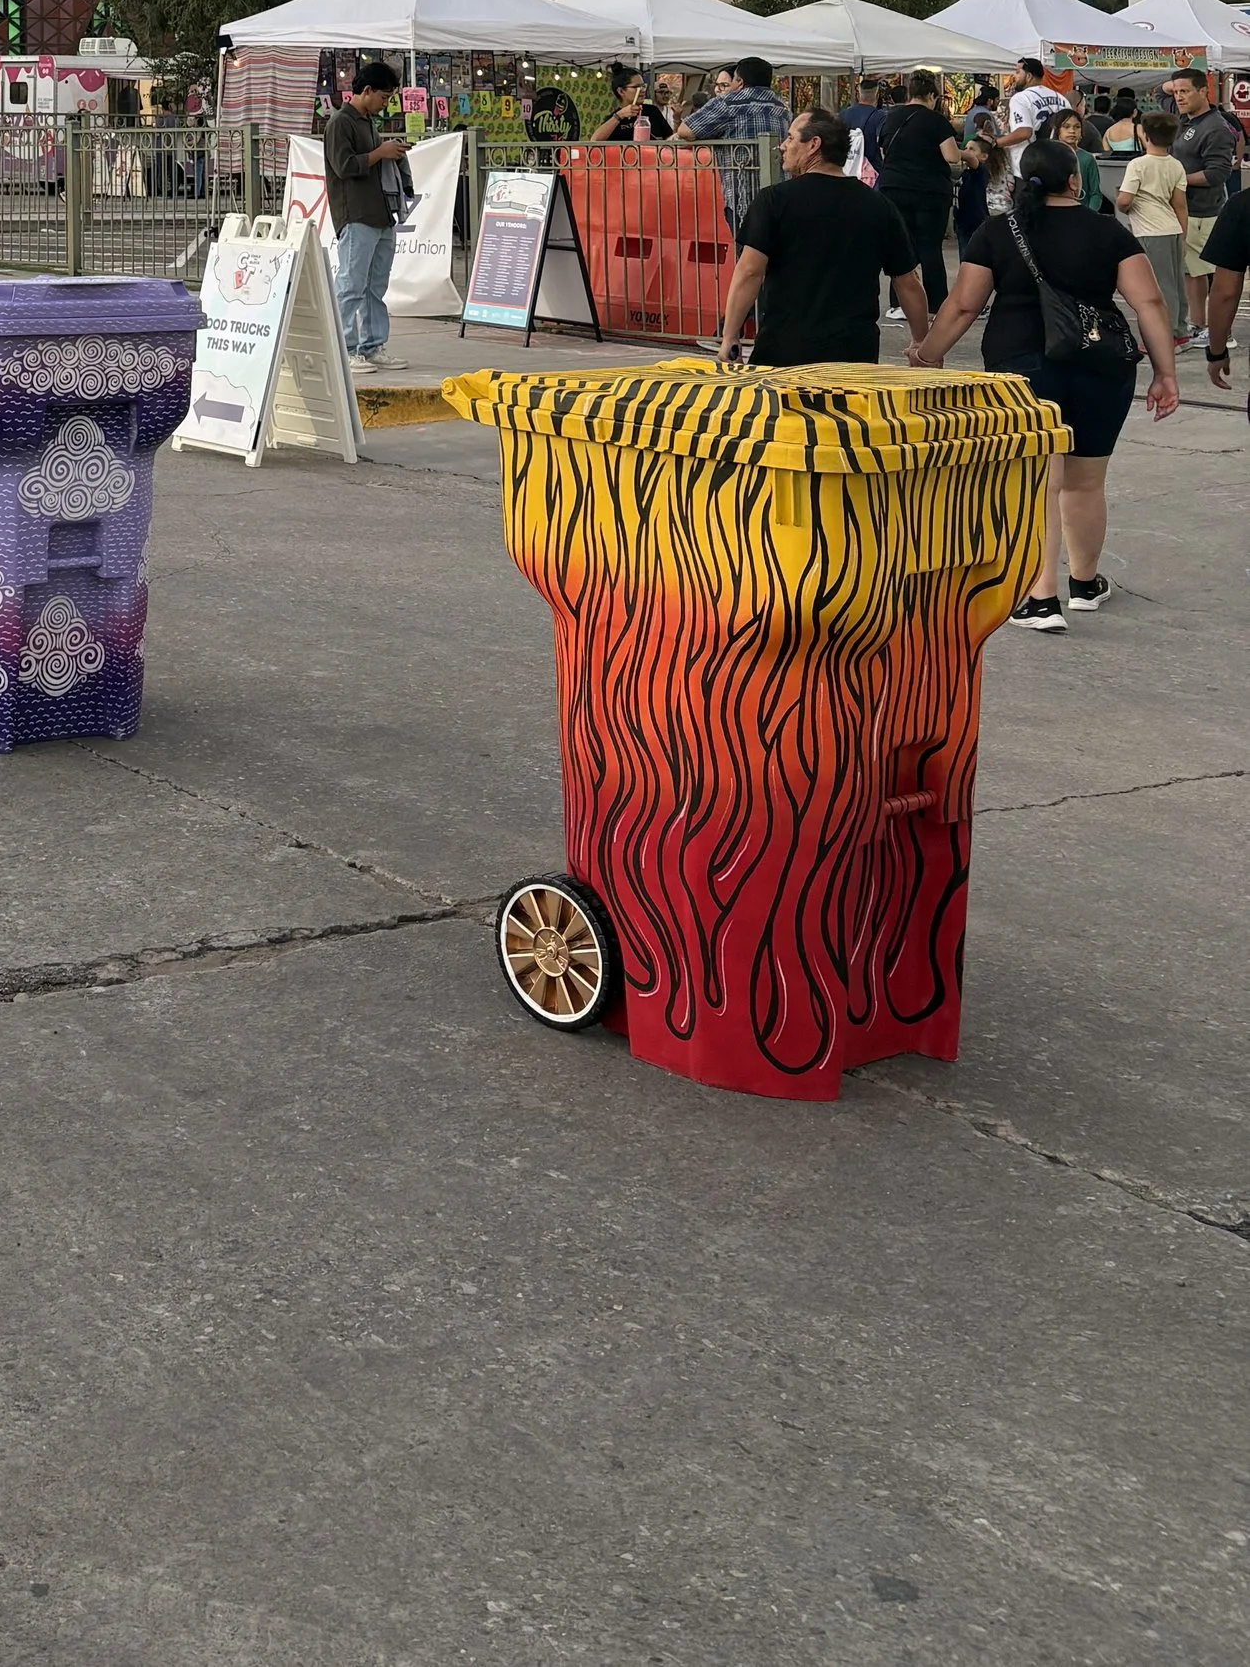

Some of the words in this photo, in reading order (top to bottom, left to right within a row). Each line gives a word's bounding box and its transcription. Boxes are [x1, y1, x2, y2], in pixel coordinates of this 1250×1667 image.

[390, 95, 398, 107] 4
[438, 100, 445, 111] 6
[459, 98, 466, 108] 7
[504, 99, 511, 112] 9
[523, 104, 531, 113] 10
[410, 239, 446, 255] Union
[207, 318, 227, 330] OOD
[230, 320, 271, 337] TRUCKS
[207, 337, 230, 351] THIS
[232, 340, 256, 355] WAY
